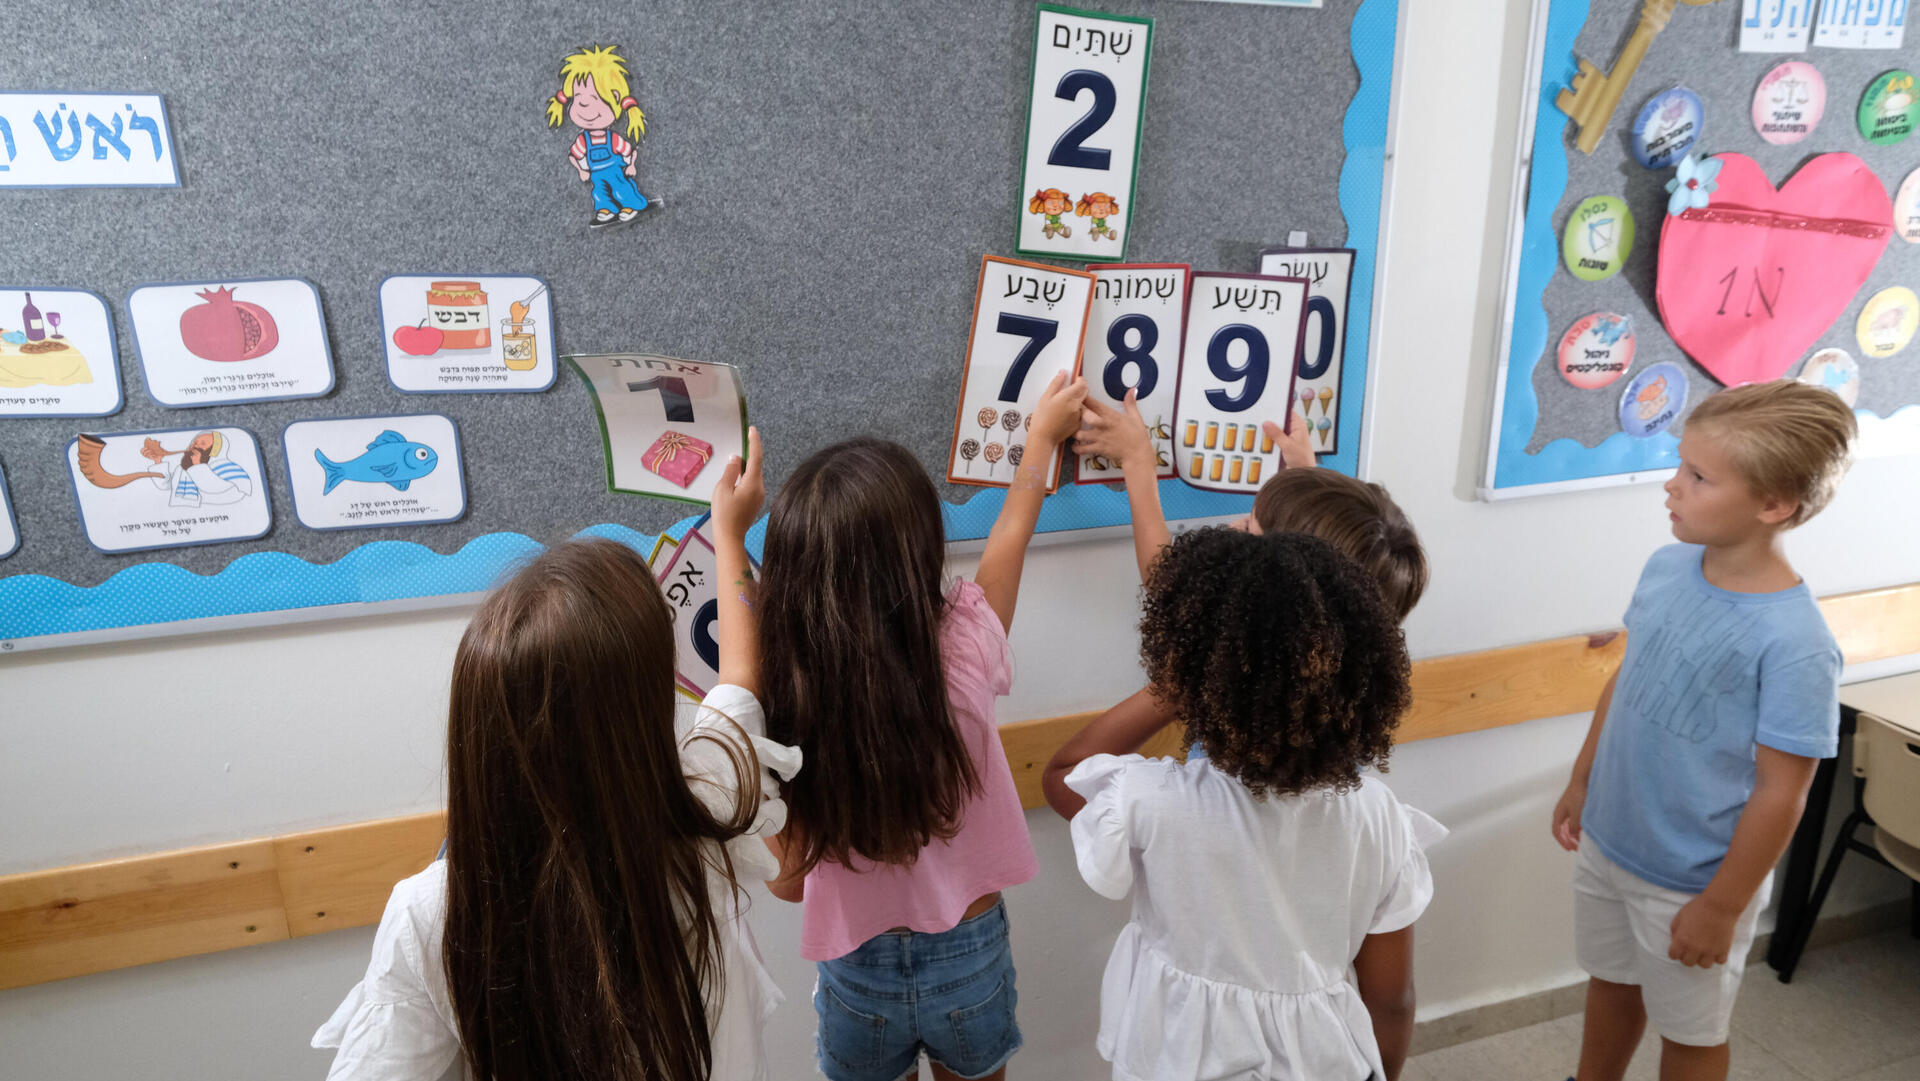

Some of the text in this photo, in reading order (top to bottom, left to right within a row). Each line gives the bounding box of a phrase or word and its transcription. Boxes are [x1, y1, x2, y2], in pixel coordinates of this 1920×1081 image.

[1047, 69, 1117, 171] 2
[434, 310, 481, 324] דבש
[996, 311, 1059, 403] 7
[1103, 313, 1159, 402] 8
[1297, 295, 1337, 381] 0
[1204, 323, 1270, 413] 9
